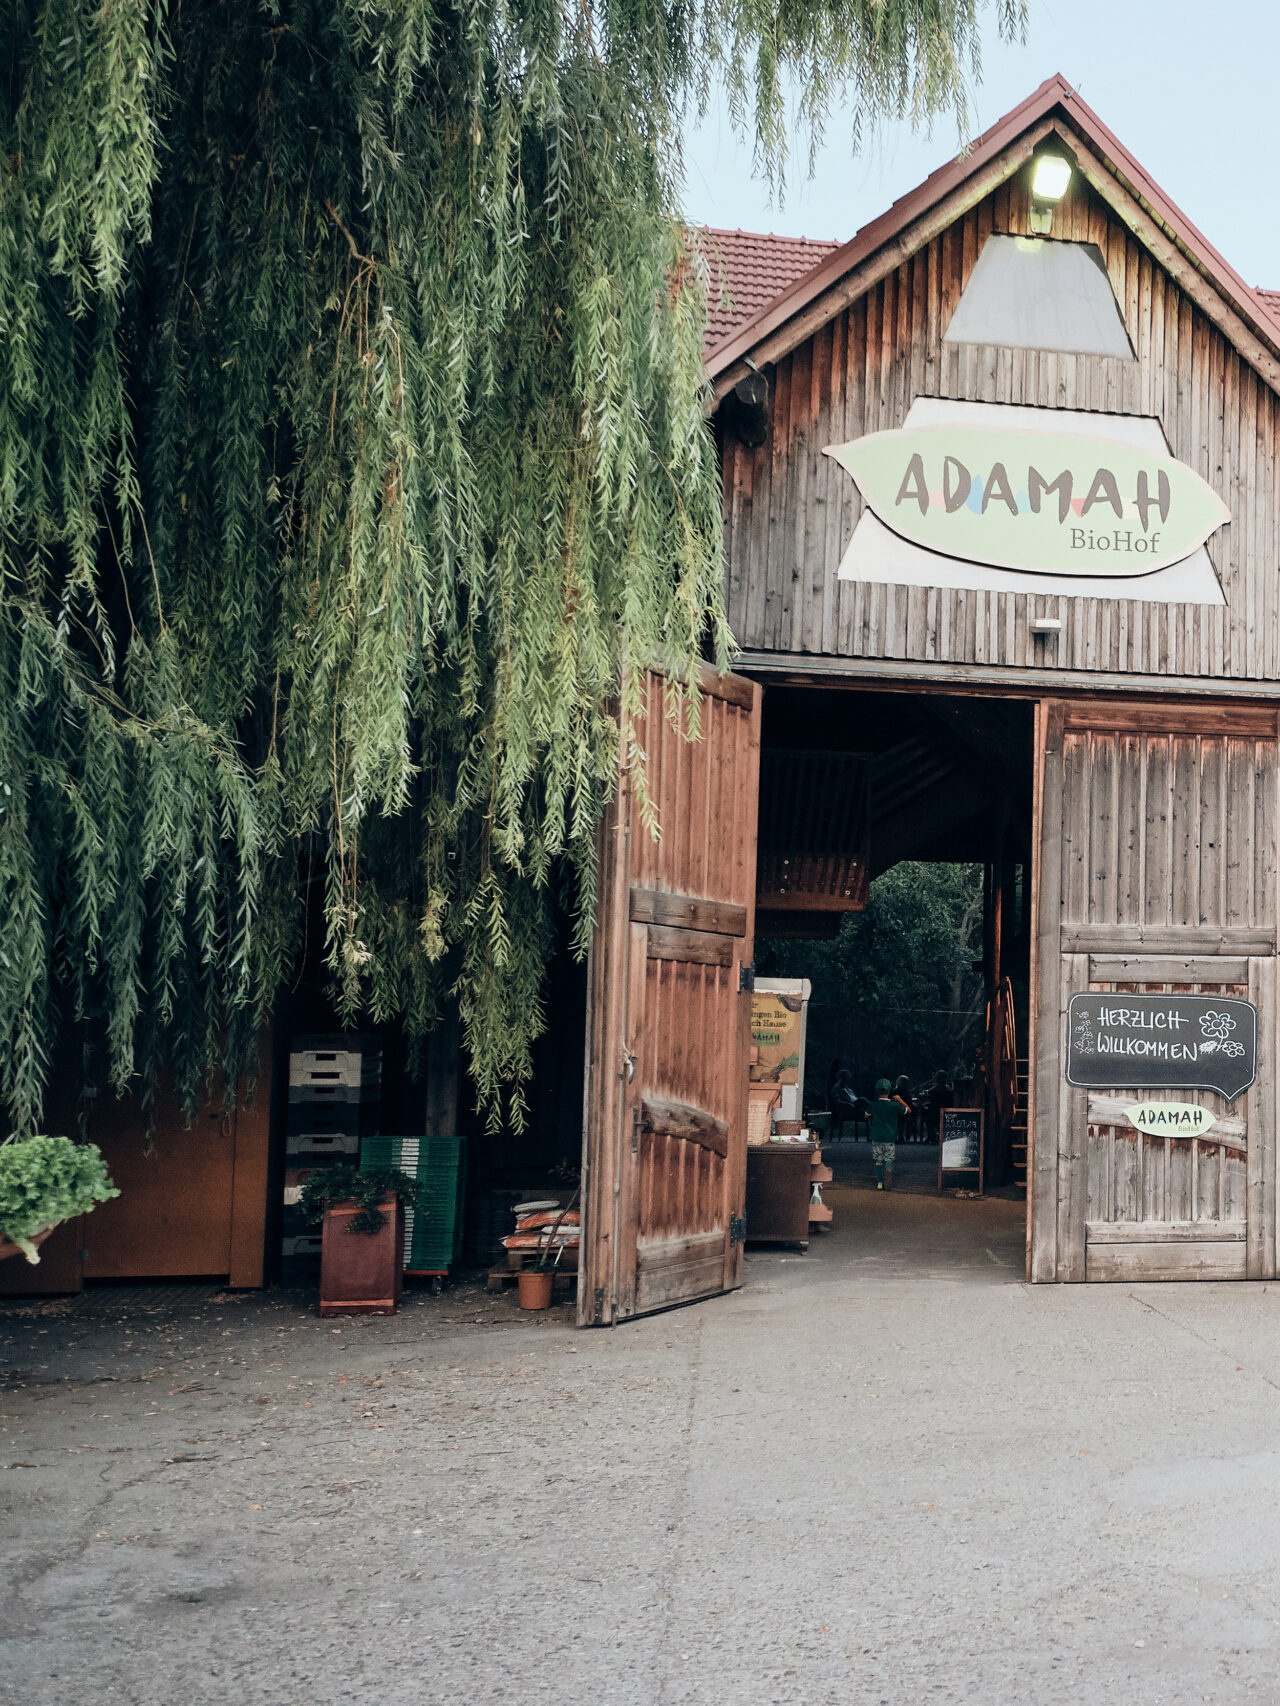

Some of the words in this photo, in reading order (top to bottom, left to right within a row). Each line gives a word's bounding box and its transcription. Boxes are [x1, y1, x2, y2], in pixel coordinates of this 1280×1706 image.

[895, 452, 1171, 533] ADAMAH
[1070, 528, 1161, 553] BioHof
[1097, 1007, 1189, 1029] HERZLICH
[1097, 1032, 1198, 1061] WILLKOMMEN
[1138, 1110, 1202, 1126] ADAMAH
